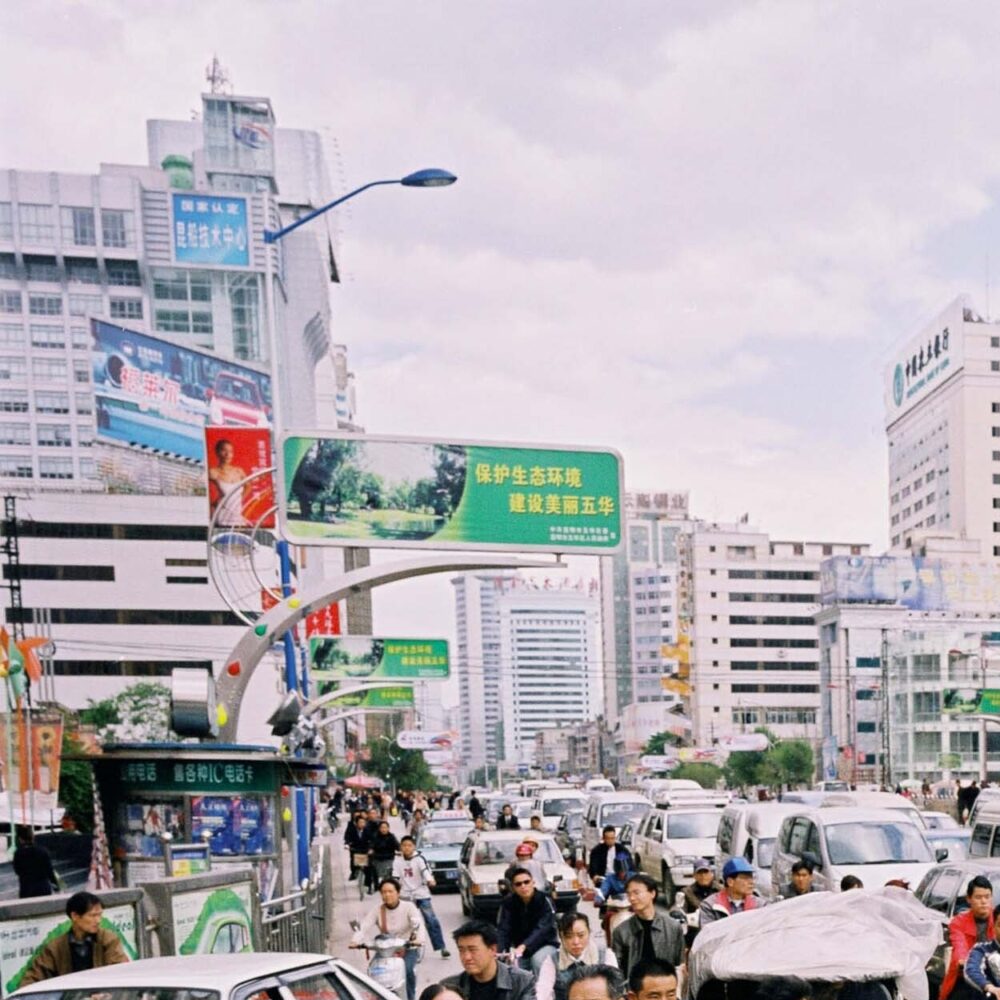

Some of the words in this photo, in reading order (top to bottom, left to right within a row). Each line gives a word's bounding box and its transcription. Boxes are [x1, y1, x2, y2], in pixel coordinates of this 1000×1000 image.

[475, 464, 582, 488] 保护生态环境
[509, 493, 615, 516] 建设美丽五华
